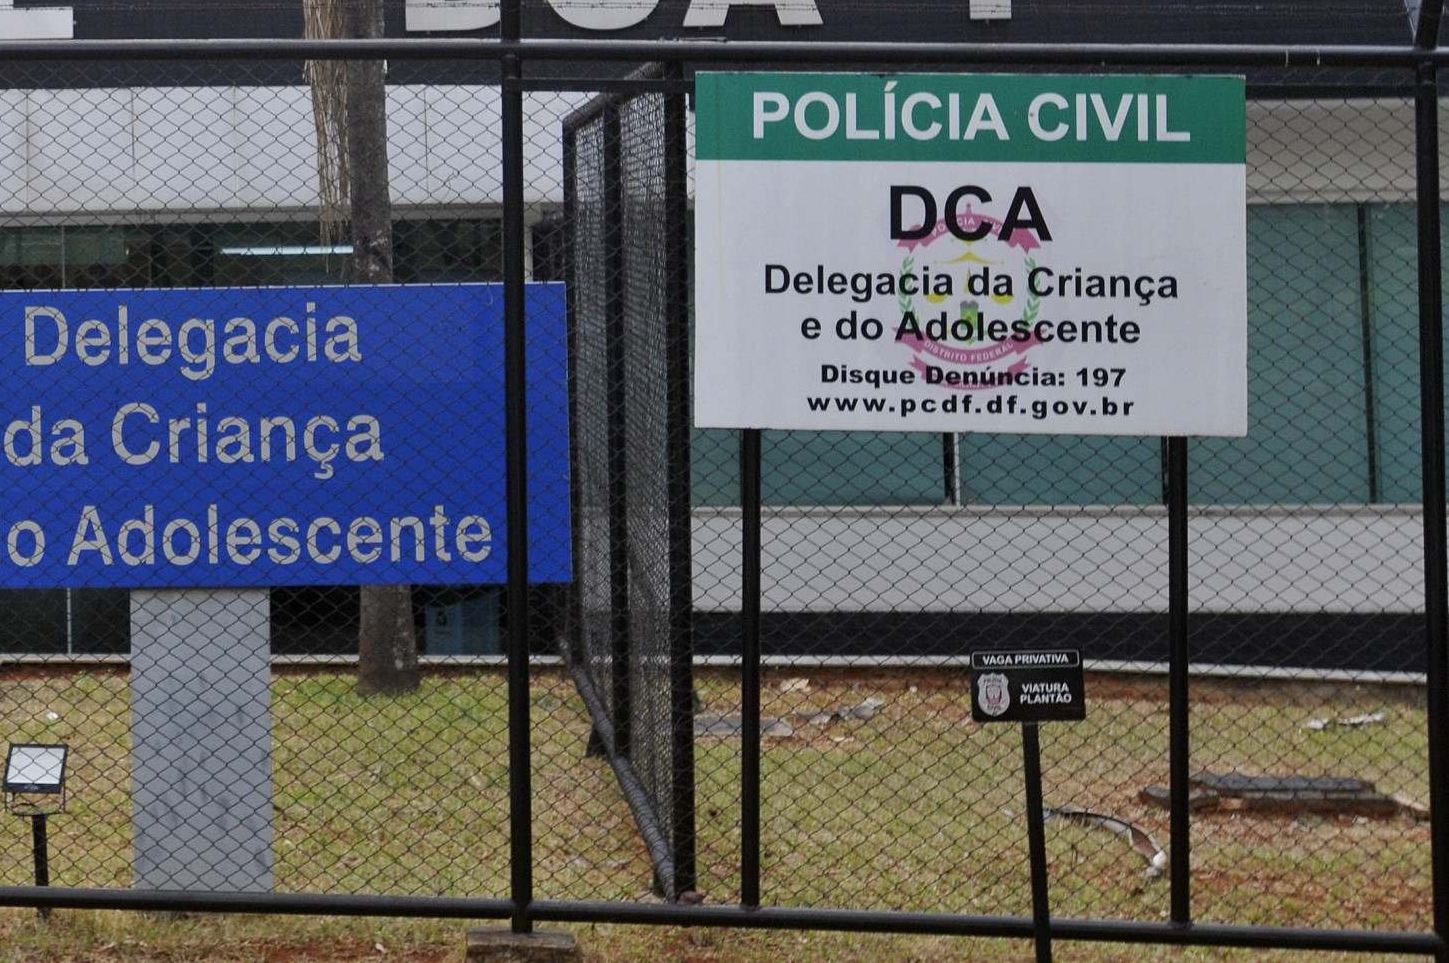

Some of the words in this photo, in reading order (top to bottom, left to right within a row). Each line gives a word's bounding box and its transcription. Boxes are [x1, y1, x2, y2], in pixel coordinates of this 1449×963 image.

[753, 81, 1010, 140] POLÍCIA
[1027, 93, 1191, 141] CIVIL
[890, 185, 1052, 242] DCA
[765, 264, 953, 303] Delegacia
[967, 266, 1013, 297] da
[1027, 266, 1178, 306] Criança
[24, 302, 362, 380] Delegacia
[801, 317, 822, 340] e
[835, 310, 884, 341] do
[895, 310, 1141, 344] Adolescente
[821, 364, 916, 389] Disque
[925, 365, 1066, 387] Denúncia:
[1076, 367, 1126, 387] 197
[807, 394, 1134, 419] www.pcdf.df.gov.br
[3, 405, 89, 467] da
[111, 402, 384, 479] Criança
[67, 504, 492, 567] Adolescente
[982, 654, 1013, 665] VAGA
[1014, 653, 1069, 665] PRIVATIVA
[1021, 682, 1070, 693] VIATURA
